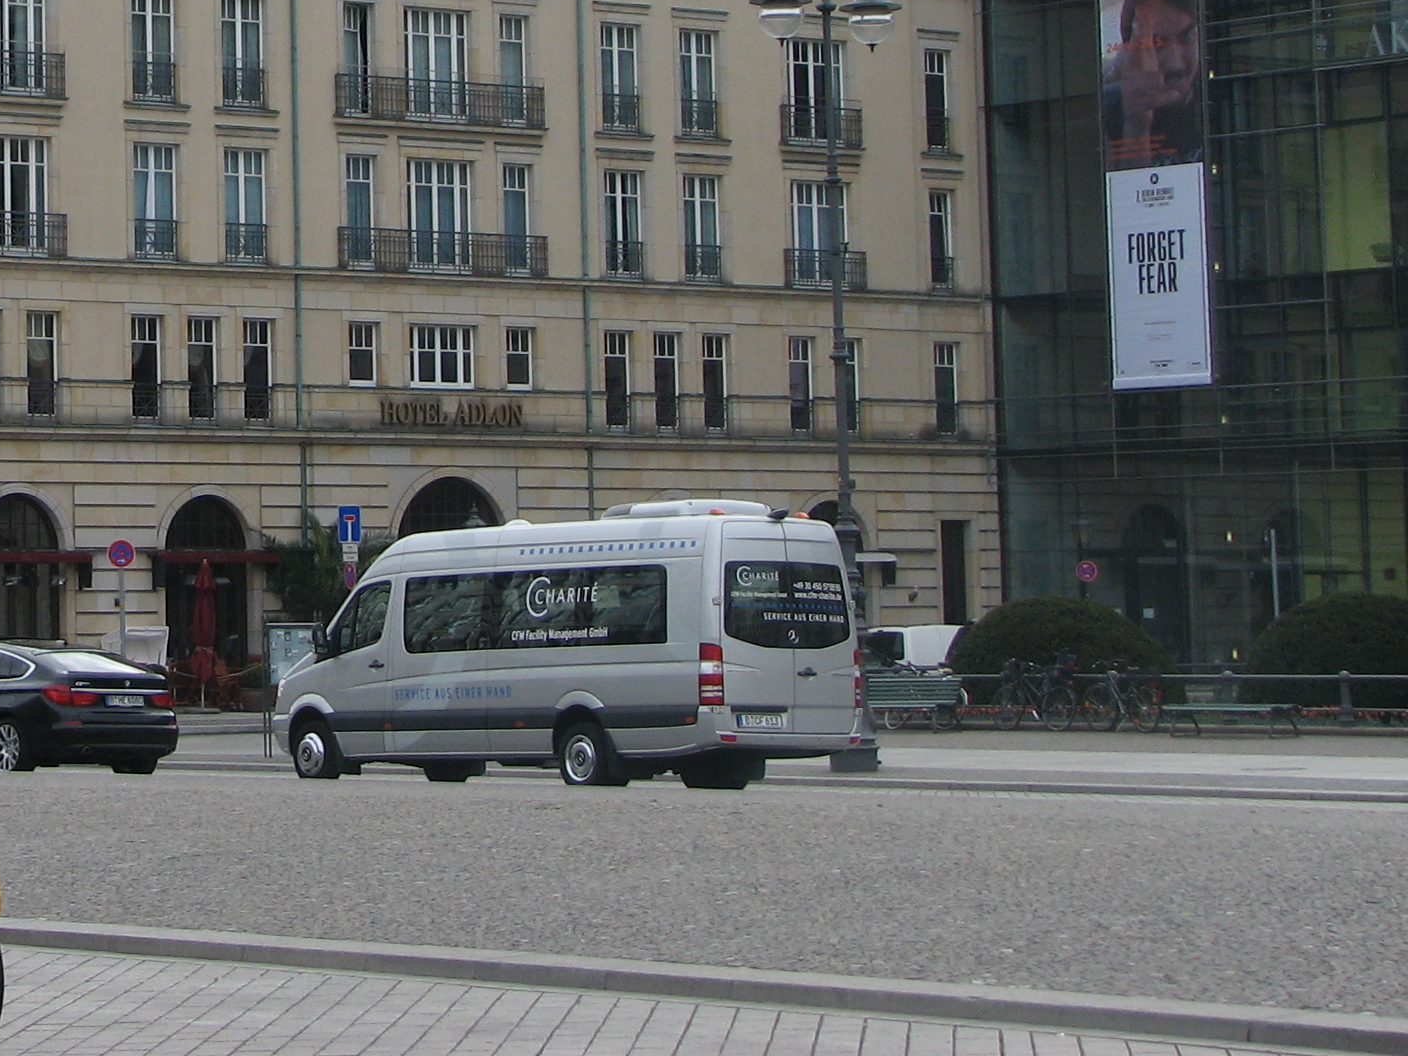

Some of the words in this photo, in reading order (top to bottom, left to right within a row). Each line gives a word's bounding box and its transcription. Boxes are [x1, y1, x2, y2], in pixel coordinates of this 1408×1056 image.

[1127, 229, 1185, 264] FORGET
[1138, 262, 1178, 294] FEAR
[379, 399, 448, 426] HOTEL
[454, 400, 524, 427] ADLON
[763, 611, 792, 621] SERVICE
[793, 613, 806, 621] AUS
[828, 615, 845, 623] HAND
[525, 629, 547, 642] Facility
[548, 628, 588, 641] Management
[588, 626, 608, 638] GmbH
[394, 688, 431, 701] SERVICE
[435, 687, 452, 700] AUS
[486, 686, 512, 698] HAND
